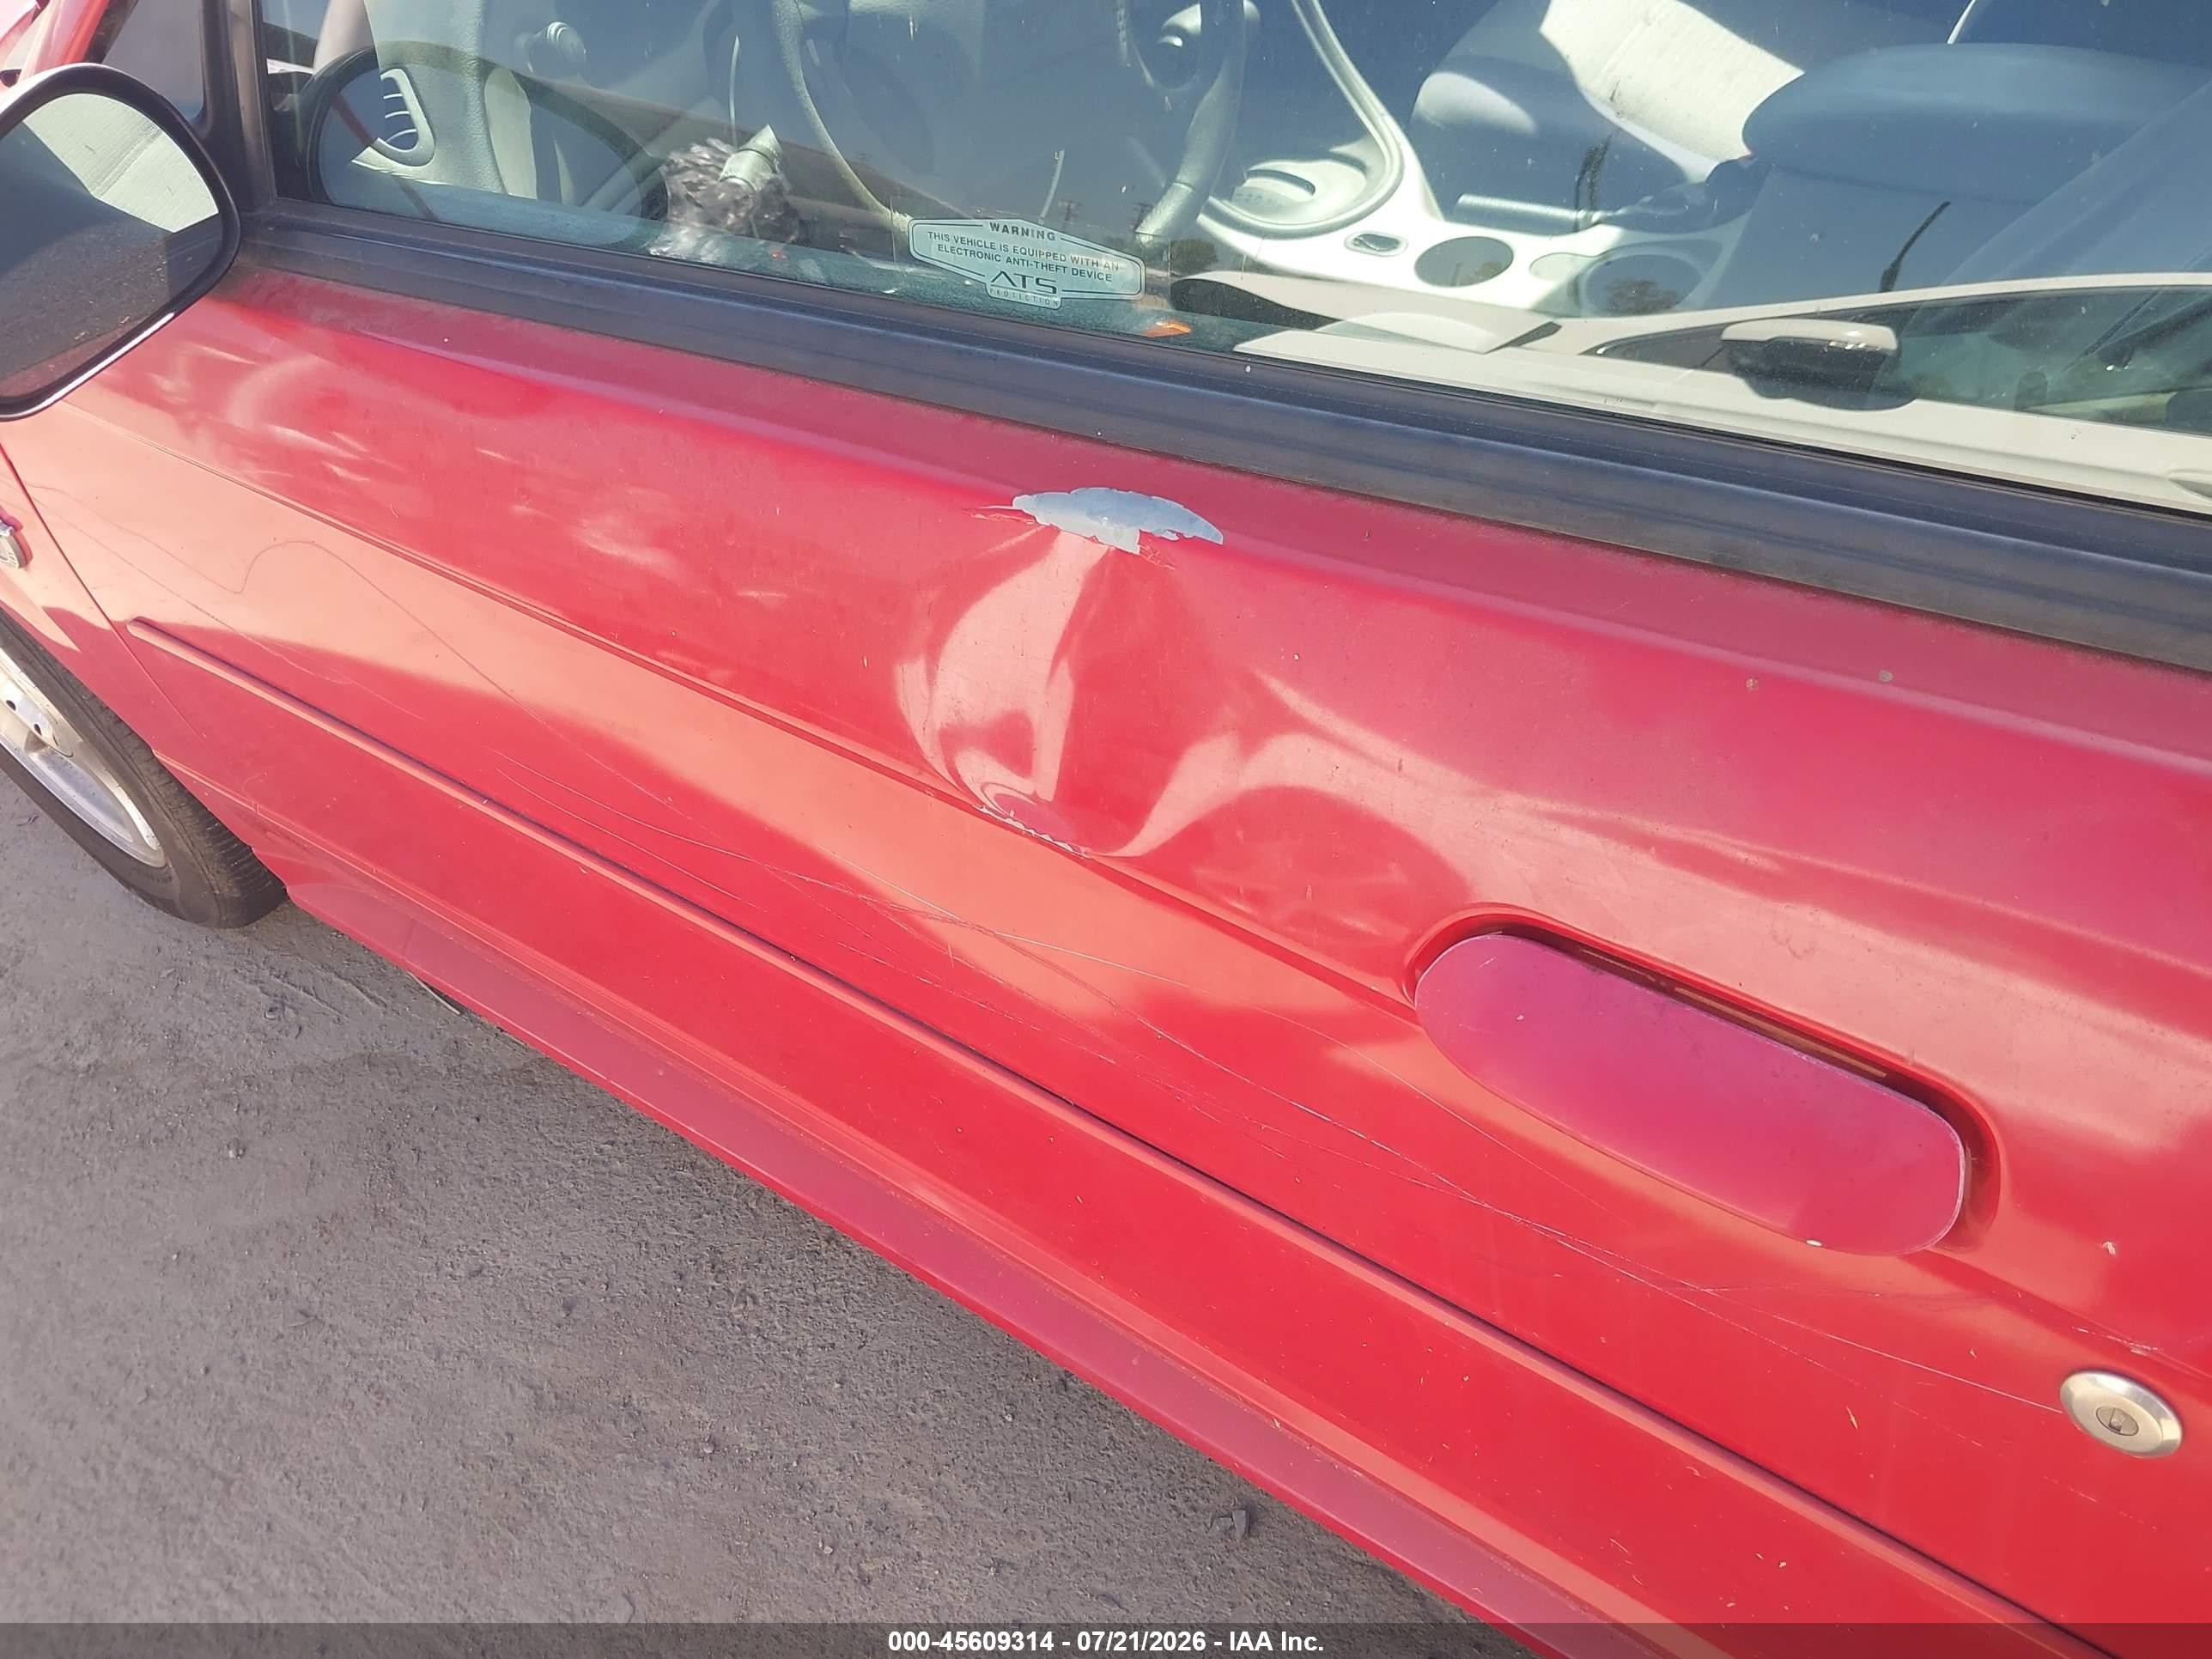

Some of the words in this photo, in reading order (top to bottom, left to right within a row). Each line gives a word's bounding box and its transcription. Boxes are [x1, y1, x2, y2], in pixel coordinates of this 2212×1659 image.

[989, 222, 1055, 240] WARNING
[927, 231, 950, 242] THIS
[953, 235, 996, 250] VEHICLE
[1000, 243, 1009, 252] IS
[1012, 246, 1066, 262] EQUIPPED
[1070, 255, 1099, 267] WITH
[1103, 261, 1119, 270] AN
[938, 244, 1001, 262] ELECTRONIC
[1006, 256, 1068, 274] ANTI-THEFT
[1071, 267, 1112, 282] DEVICE
[990, 270, 1057, 295] ATS
[989, 288, 1058, 307] PROTECTION
